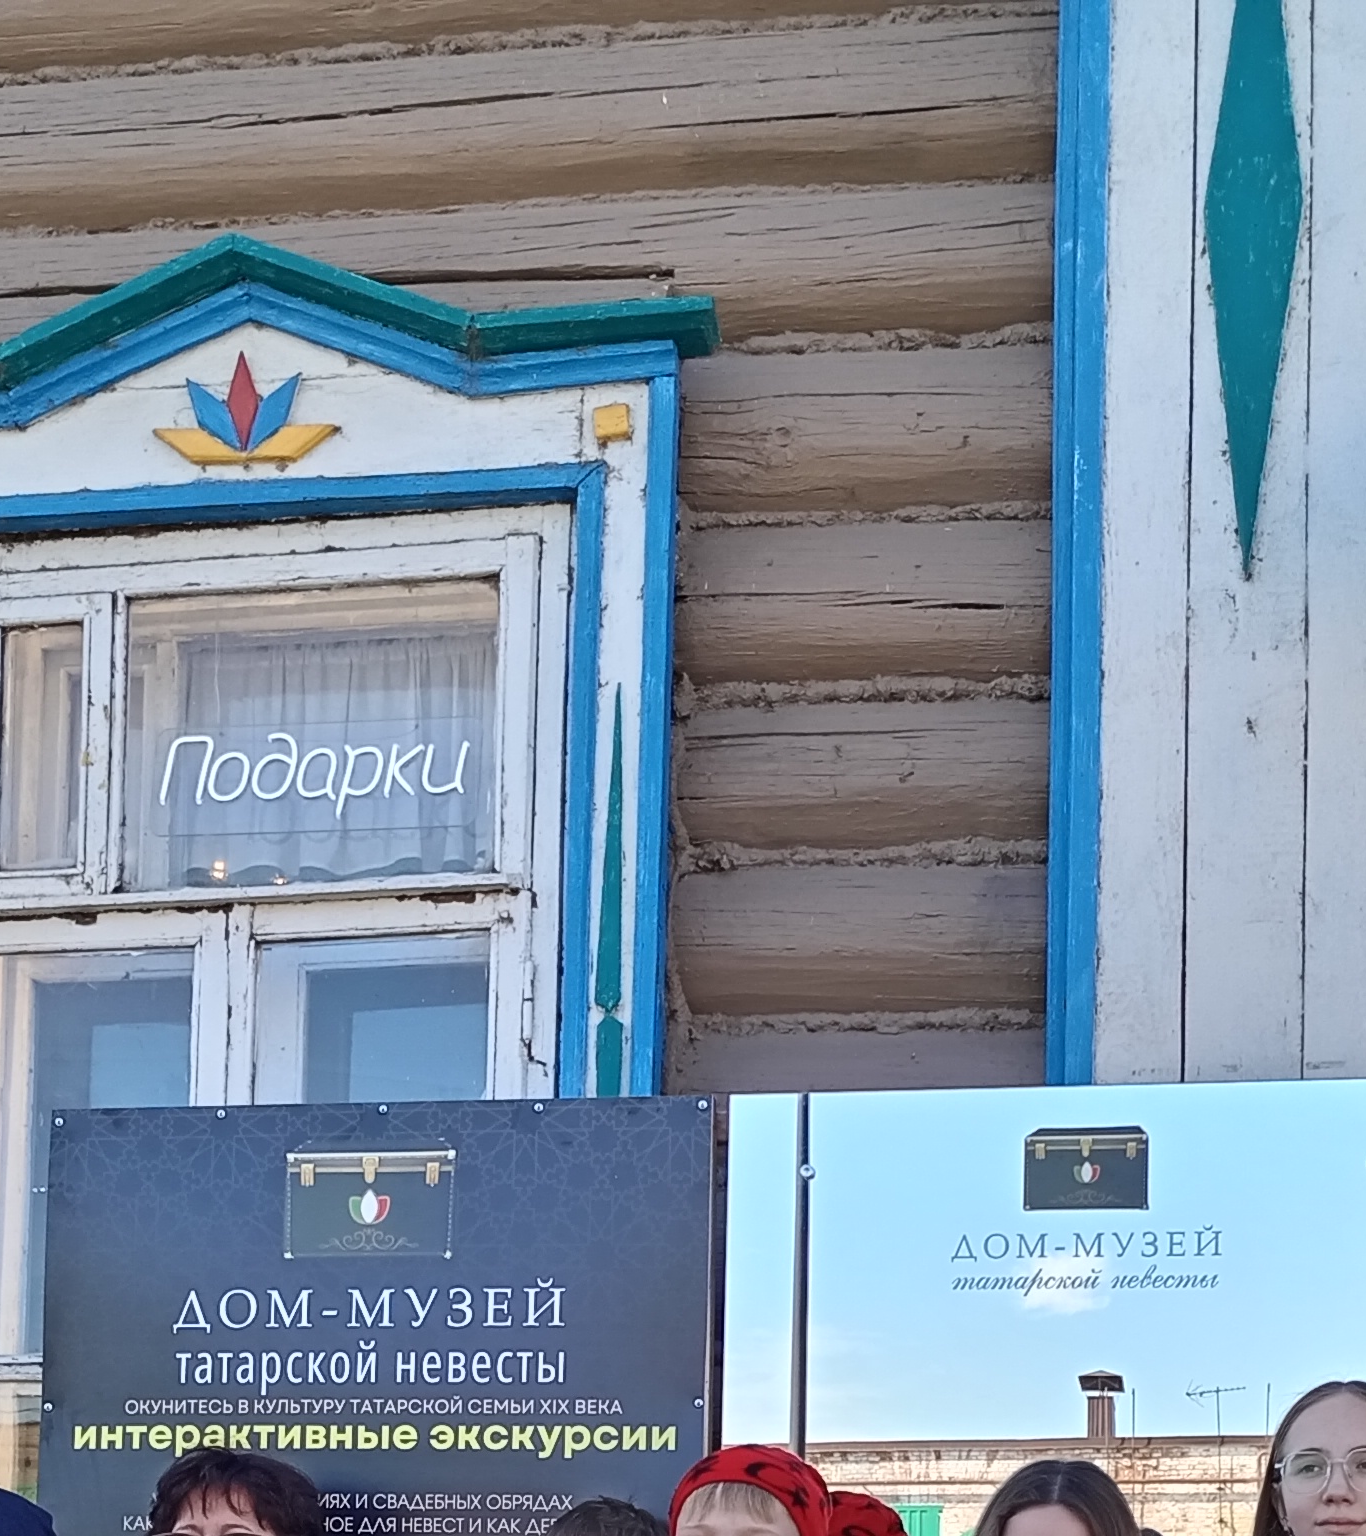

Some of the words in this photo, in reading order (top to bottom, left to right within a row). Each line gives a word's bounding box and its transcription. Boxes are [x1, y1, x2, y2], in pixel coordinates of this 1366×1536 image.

[159, 732, 471, 820] Подарки
[951, 1224, 1222, 1262] ДОМ-МУЗЕЙ
[951, 1267, 1101, 1296] татарской
[1111, 1264, 1219, 1290] невесты
[173, 1278, 566, 1334] ДОМ-МУЗЕЙ
[175, 1340, 378, 1395] татарской
[395, 1349, 565, 1384] невесты
[124, 1400, 233, 1415] ОКУНИТЕСЬ
[238, 1401, 249, 1414] В
[254, 1400, 345, 1415] КУЛЬТУРУ
[350, 1395, 463, 1415] ТАТАРСКОЙ
[467, 1400, 534, 1414] СЕМЬИ
[539, 1400, 570, 1414] XIX
[575, 1400, 622, 1414] ВЕКА
[72, 1424, 418, 1458] интерактивные
[429, 1421, 676, 1458] экскурсии
[356, 1494, 368, 1509] И
[373, 1494, 482, 1511] СВАДЕБНЫХ
[486, 1494, 573, 1512] ОБРЯДАХ
[358, 1517, 397, 1534] ДЛЯ
[402, 1517, 465, 1533] НЕВЕСТ
[469, 1518, 481, 1533] И
[487, 1518, 521, 1533] КАК
